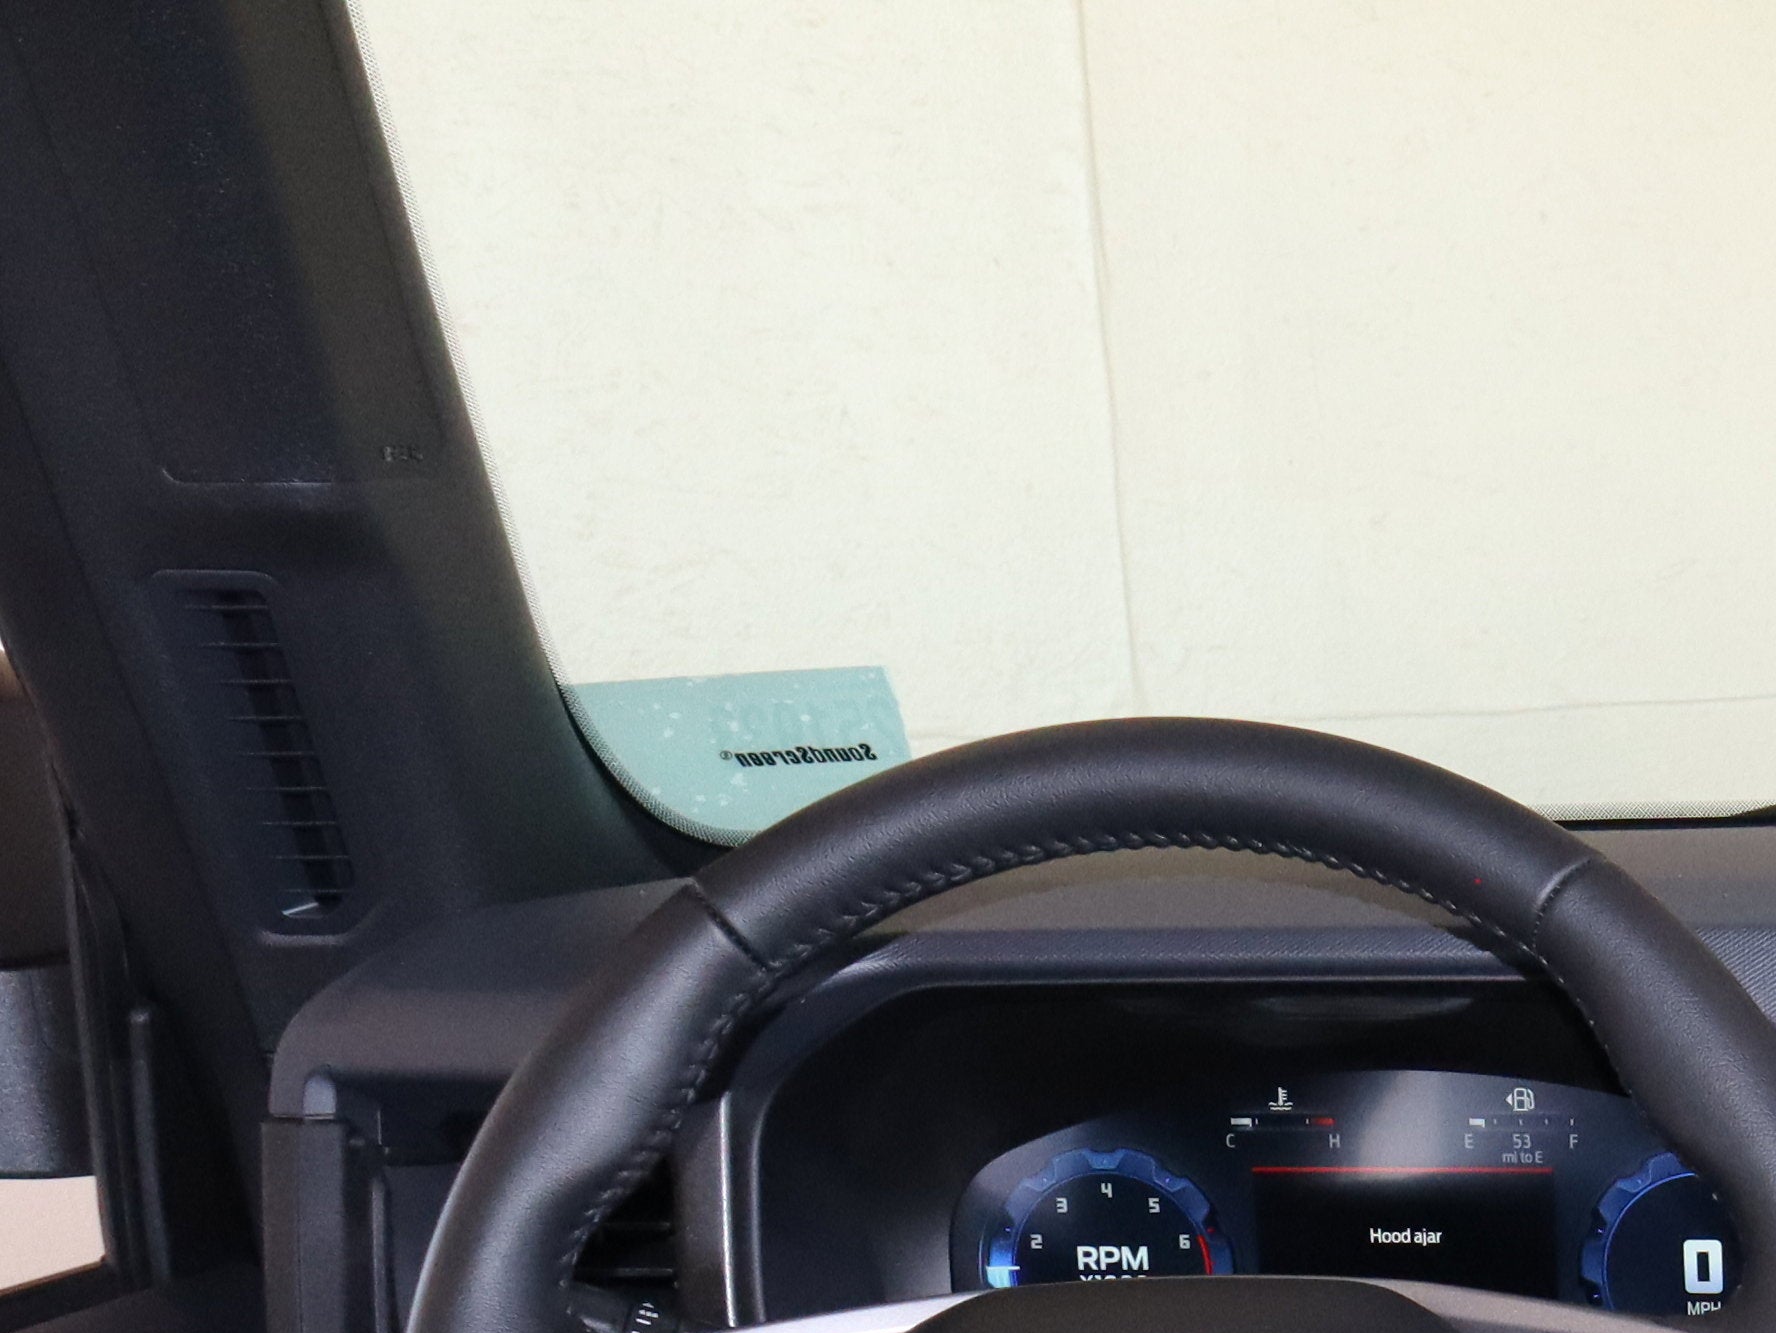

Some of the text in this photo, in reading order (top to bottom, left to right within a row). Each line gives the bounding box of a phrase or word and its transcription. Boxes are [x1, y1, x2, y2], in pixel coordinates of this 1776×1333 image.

[1226, 1134, 1236, 1148] C
[1328, 1133, 1341, 1148] H
[1464, 1134, 1474, 1149] E
[1512, 1133, 1532, 1150] 53
[1569, 1134, 1578, 1149] F
[1502, 1151, 1544, 1164] mi to E
[1100, 1182, 1113, 1198] 4
[1056, 1197, 1068, 1213] 3
[1148, 1198, 1160, 1213] 5
[1031, 1234, 1043, 1249] 2
[1179, 1234, 1191, 1250] 6
[1369, 1228, 1443, 1247] Hood ajar
[1076, 1245, 1150, 1271] RPM
[1682, 1238, 1724, 1294] 0
[1686, 1301, 1722, 1315] MPH
